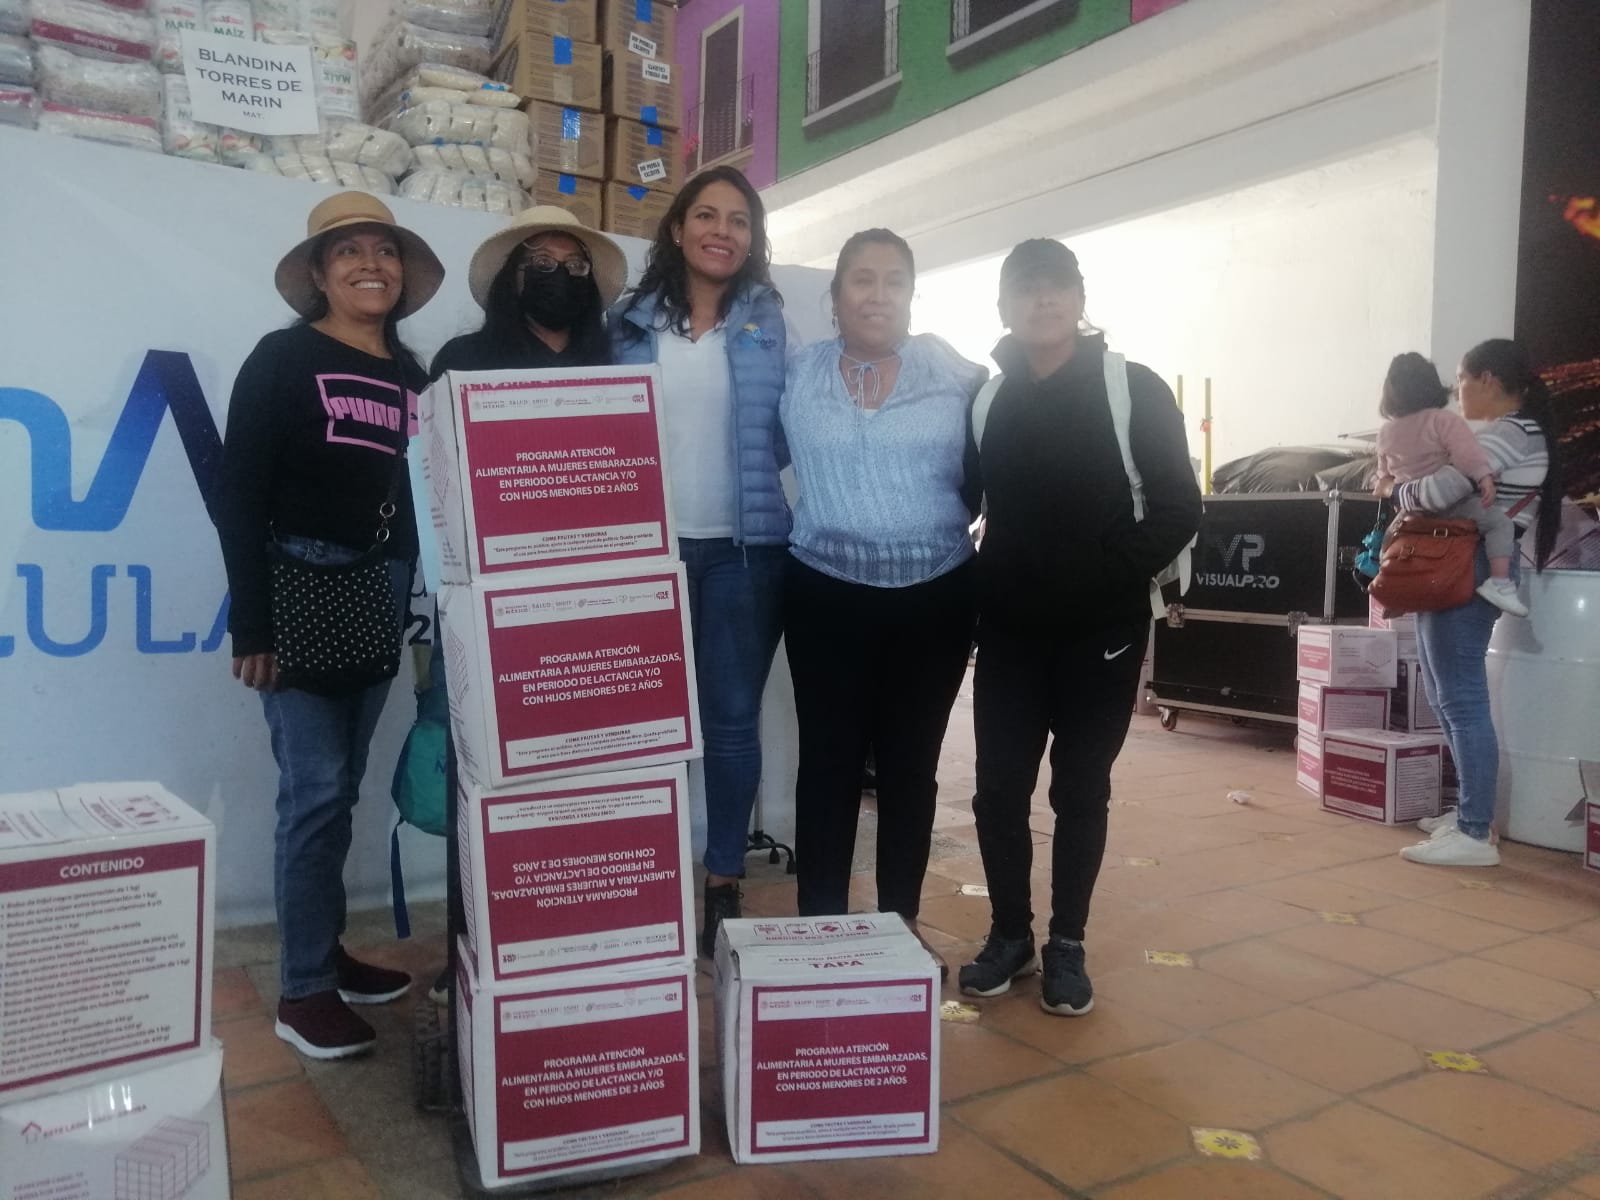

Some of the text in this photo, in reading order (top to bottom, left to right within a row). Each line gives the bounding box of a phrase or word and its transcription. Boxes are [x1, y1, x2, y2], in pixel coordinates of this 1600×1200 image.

[198, 48, 296, 72] BLANDINA
[196, 67, 302, 92] TORRES DE
[222, 90, 282, 109] MARIN
[328, 396, 400, 432] PUMA
[516, 445, 615, 461] PROGRAMA ATENCIÓN
[475, 456, 657, 477] ALIMENTARIA A MUJERES EMBARAZADAS,
[499, 470, 636, 488] EN PERIODO DE LACTANCIA Y/O
[499, 481, 639, 502] CON HIJOS MENORES DE 2 AÑOS
[540, 644, 639, 664] PROGRAMA ATENCIÓN
[498, 652, 681, 682] ALIMENTARIA A MUJERES EMBARAZADAS,
[522, 667, 660, 692] EN PERIODO DE LACTANCIA Y/O
[522, 678, 662, 705] CON HIJOS MENORES DE 2 AÑOS
[60, 856, 145, 879] CONTENIDO
[513, 847, 654, 873] CON HIJOS MENORES DE 2 AÑOS
[515, 860, 654, 884] EN PERIODO DE LACTANCIA Y/O
[491, 870, 676, 900] ALIMENTARIA A MUJERES EMBARAZADAS,
[536, 887, 636, 908] PROGRAMA ATENCIÓN
[808, 960, 865, 969] TAPA
[544, 1046, 644, 1068] PROGRAMA ATENCIÓN
[795, 1042, 888, 1055] PROGRAMA ATENCIÓN
[501, 1053, 685, 1086] ALIMENTARIA A MUJERES EMBARAZADAS,
[757, 1051, 927, 1069] ALIMENTARIA A MUJERES EMBARAZADAS,
[525, 1068, 663, 1096] EN PERIODO DE LACTANCIA Y/O
[775, 1074, 907, 1091] CON HIJOS MENORES DE 2 AÑOS
[777, 1072, 788, 1080] EN
[790, 1069, 828, 1079] PERIODO
[842, 1066, 889, 1076] LACTANCIA
[891, 1064, 906, 1073] Y/O
[523, 1079, 664, 1108] CON HIJOS MENORES DE 2 AÑOS
